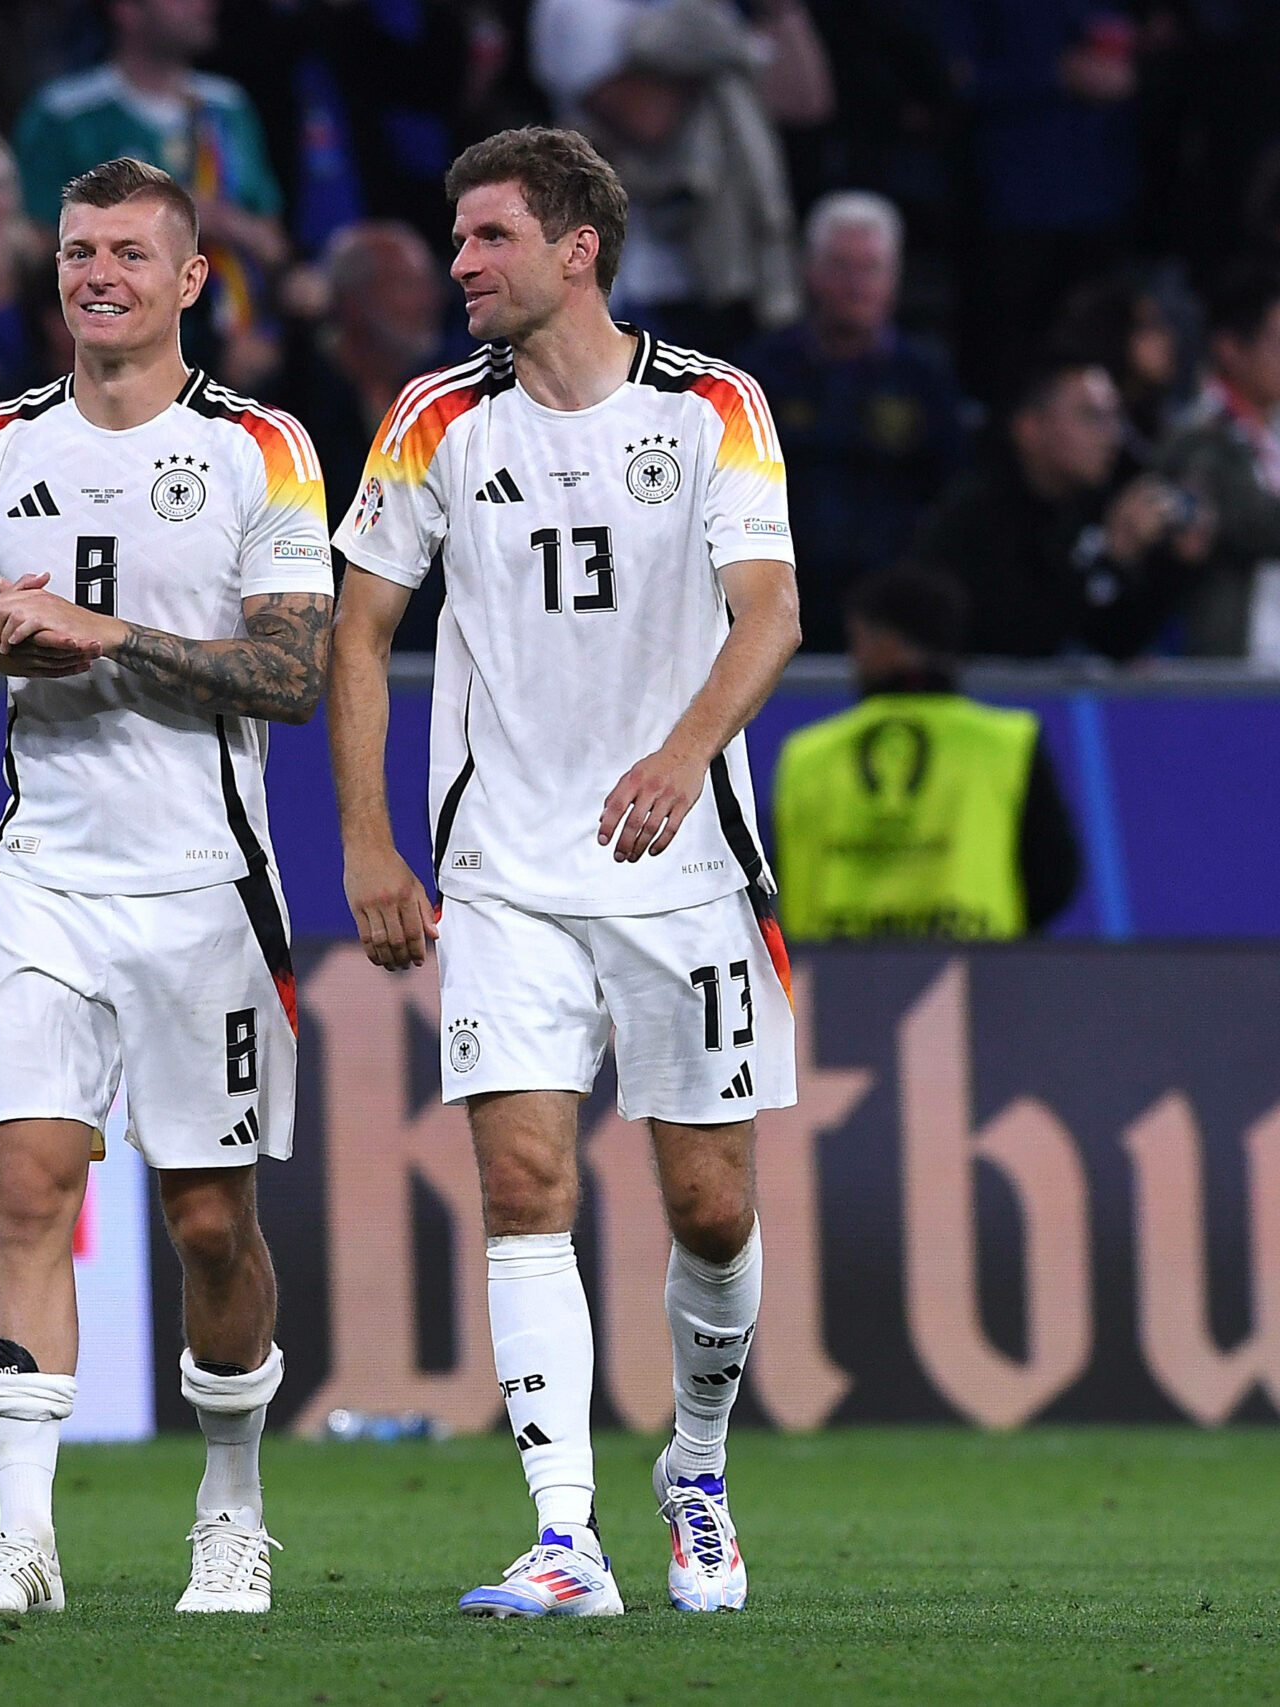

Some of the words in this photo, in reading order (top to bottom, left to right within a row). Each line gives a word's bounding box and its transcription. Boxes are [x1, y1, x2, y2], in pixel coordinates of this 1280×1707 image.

[74, 535, 119, 619] 8
[530, 526, 618, 614] 13
[681, 859, 725, 875] HEAT.RDY
[689, 958, 755, 1052] 13
[225, 1006, 259, 1097] 8
